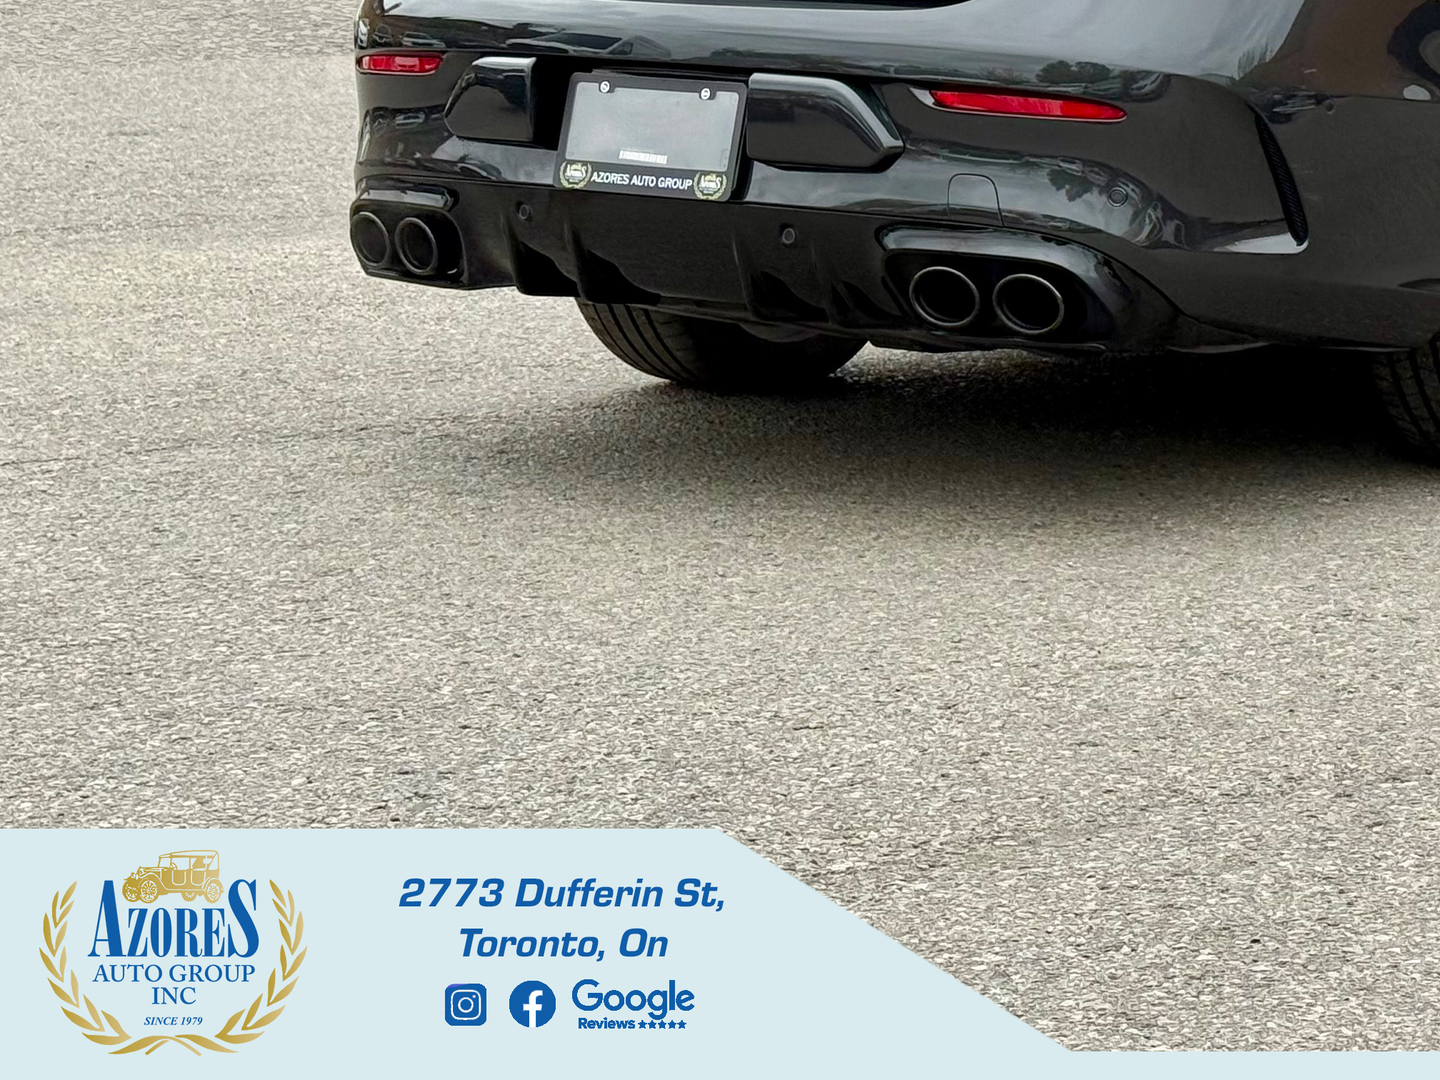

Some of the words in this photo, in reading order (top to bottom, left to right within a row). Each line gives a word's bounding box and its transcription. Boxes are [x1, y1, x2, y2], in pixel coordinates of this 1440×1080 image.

[590, 171, 630, 185] AZORES
[629, 174, 657, 188] AUTO
[657, 176, 693, 191] GROUP
